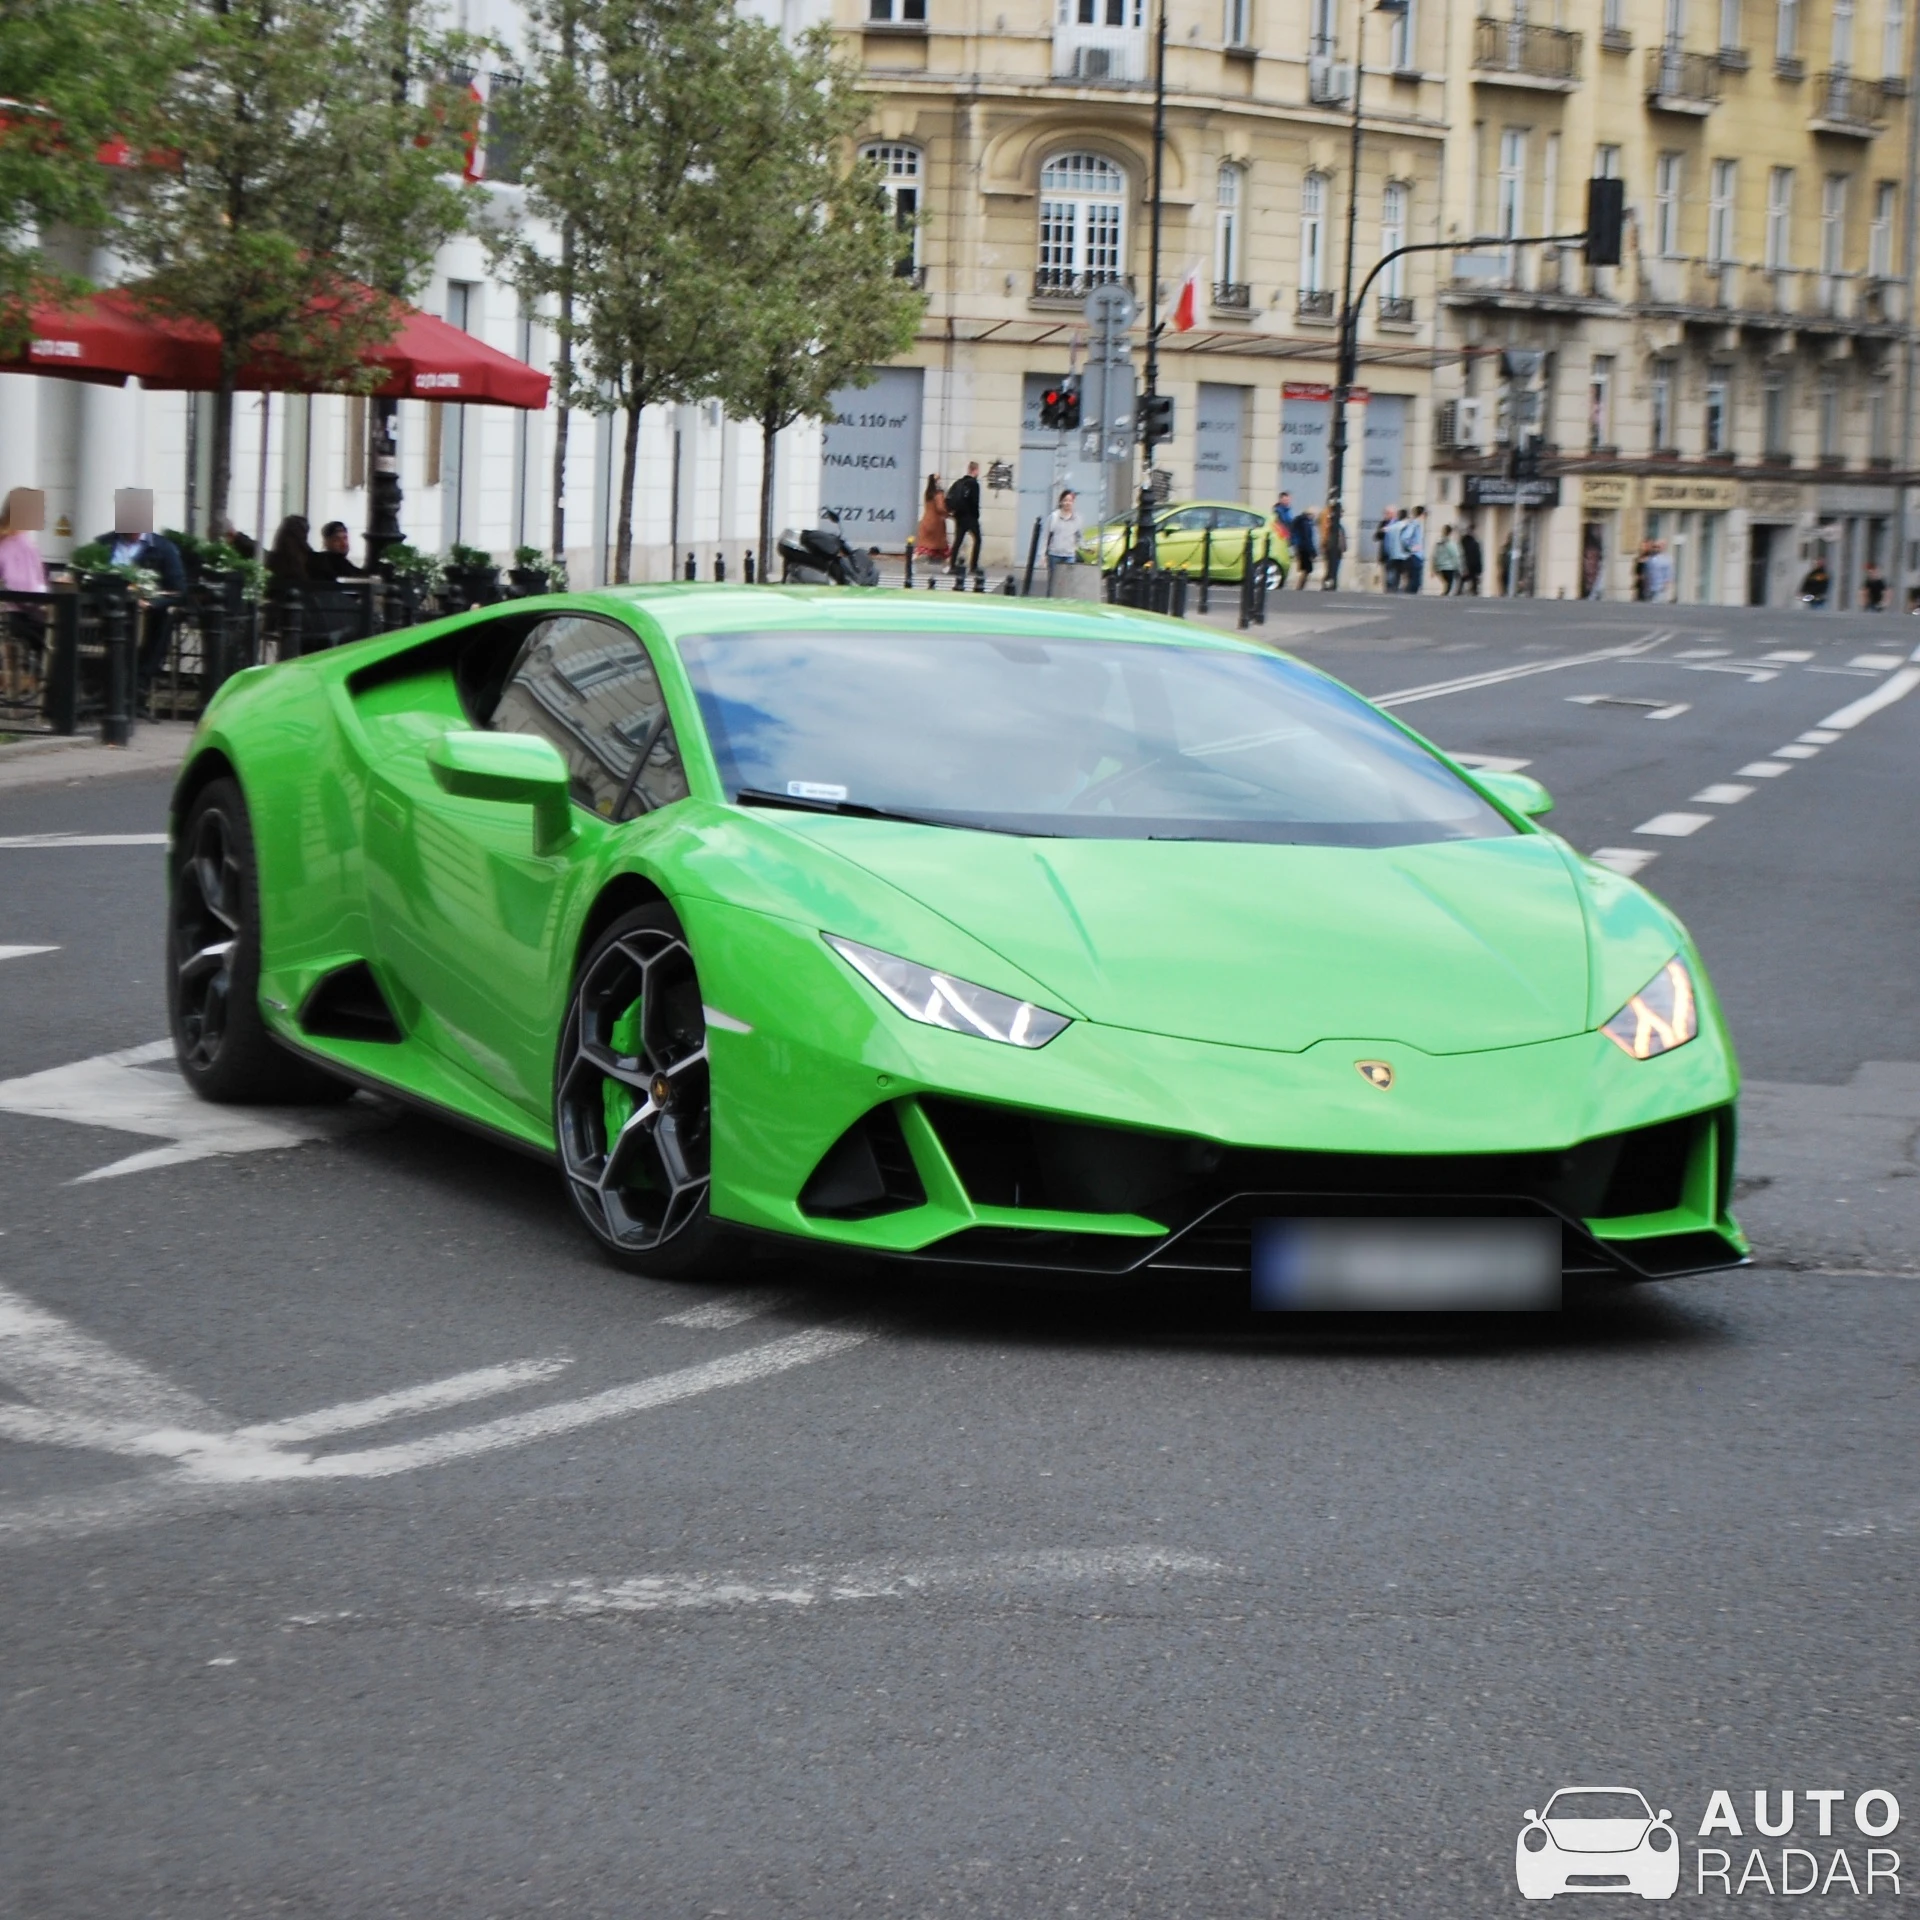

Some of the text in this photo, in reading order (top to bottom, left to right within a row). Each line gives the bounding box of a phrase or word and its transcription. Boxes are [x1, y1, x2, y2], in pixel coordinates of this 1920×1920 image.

[859, 413, 886, 428] 110
[888, 413, 908, 429] m²
[833, 506, 864, 522] 727
[867, 507, 896, 523] 144
